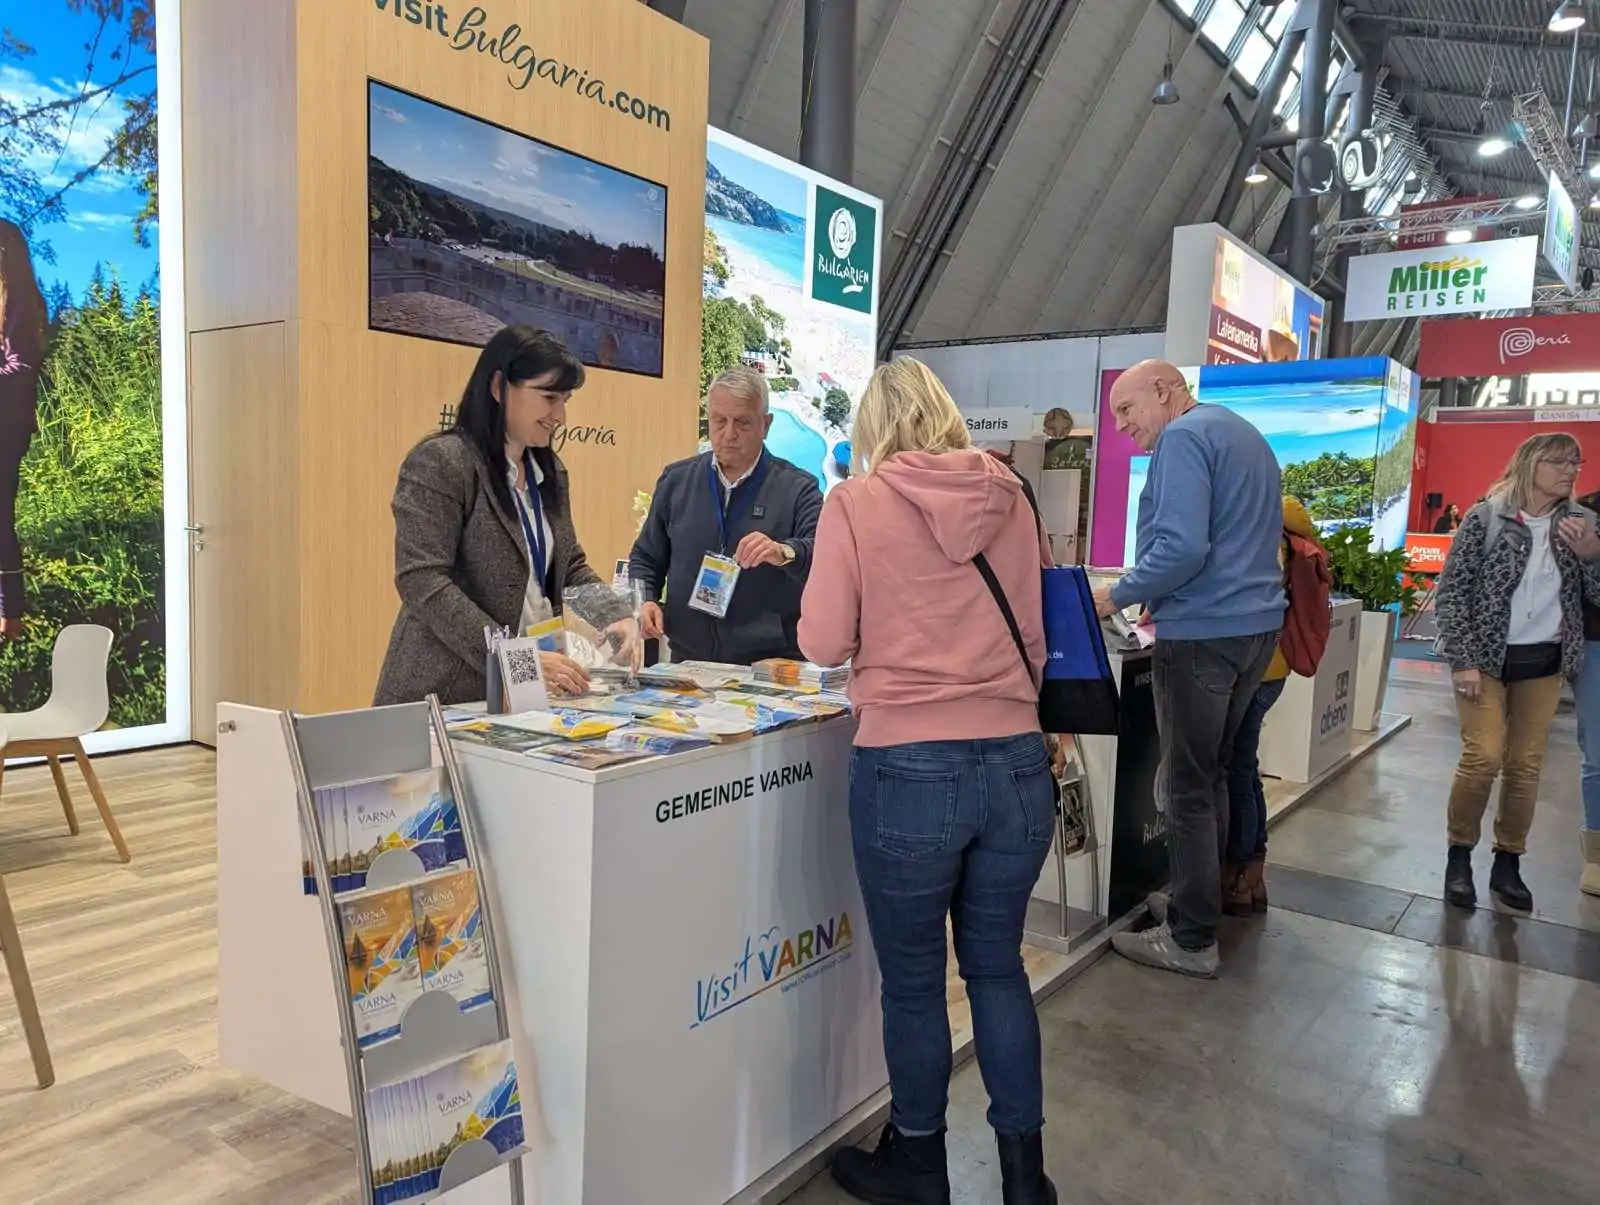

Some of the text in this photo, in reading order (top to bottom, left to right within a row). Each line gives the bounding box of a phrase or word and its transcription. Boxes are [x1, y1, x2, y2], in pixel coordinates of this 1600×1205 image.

[1388, 261, 1488, 294] Miller
[1386, 288, 1487, 311] REISEN
[966, 417, 1009, 430] Safaris
[655, 760, 814, 823] GEMEINDE VARNA
[358, 809, 397, 824] VARNA
[419, 889, 454, 907] VARNA
[348, 907, 388, 926] VARNA
[696, 935, 754, 1022] Visit
[759, 911, 853, 982] VARNA
[428, 969, 465, 988] VARNA
[358, 991, 397, 1012] VARNA
[438, 1089, 473, 1113] VARNA
